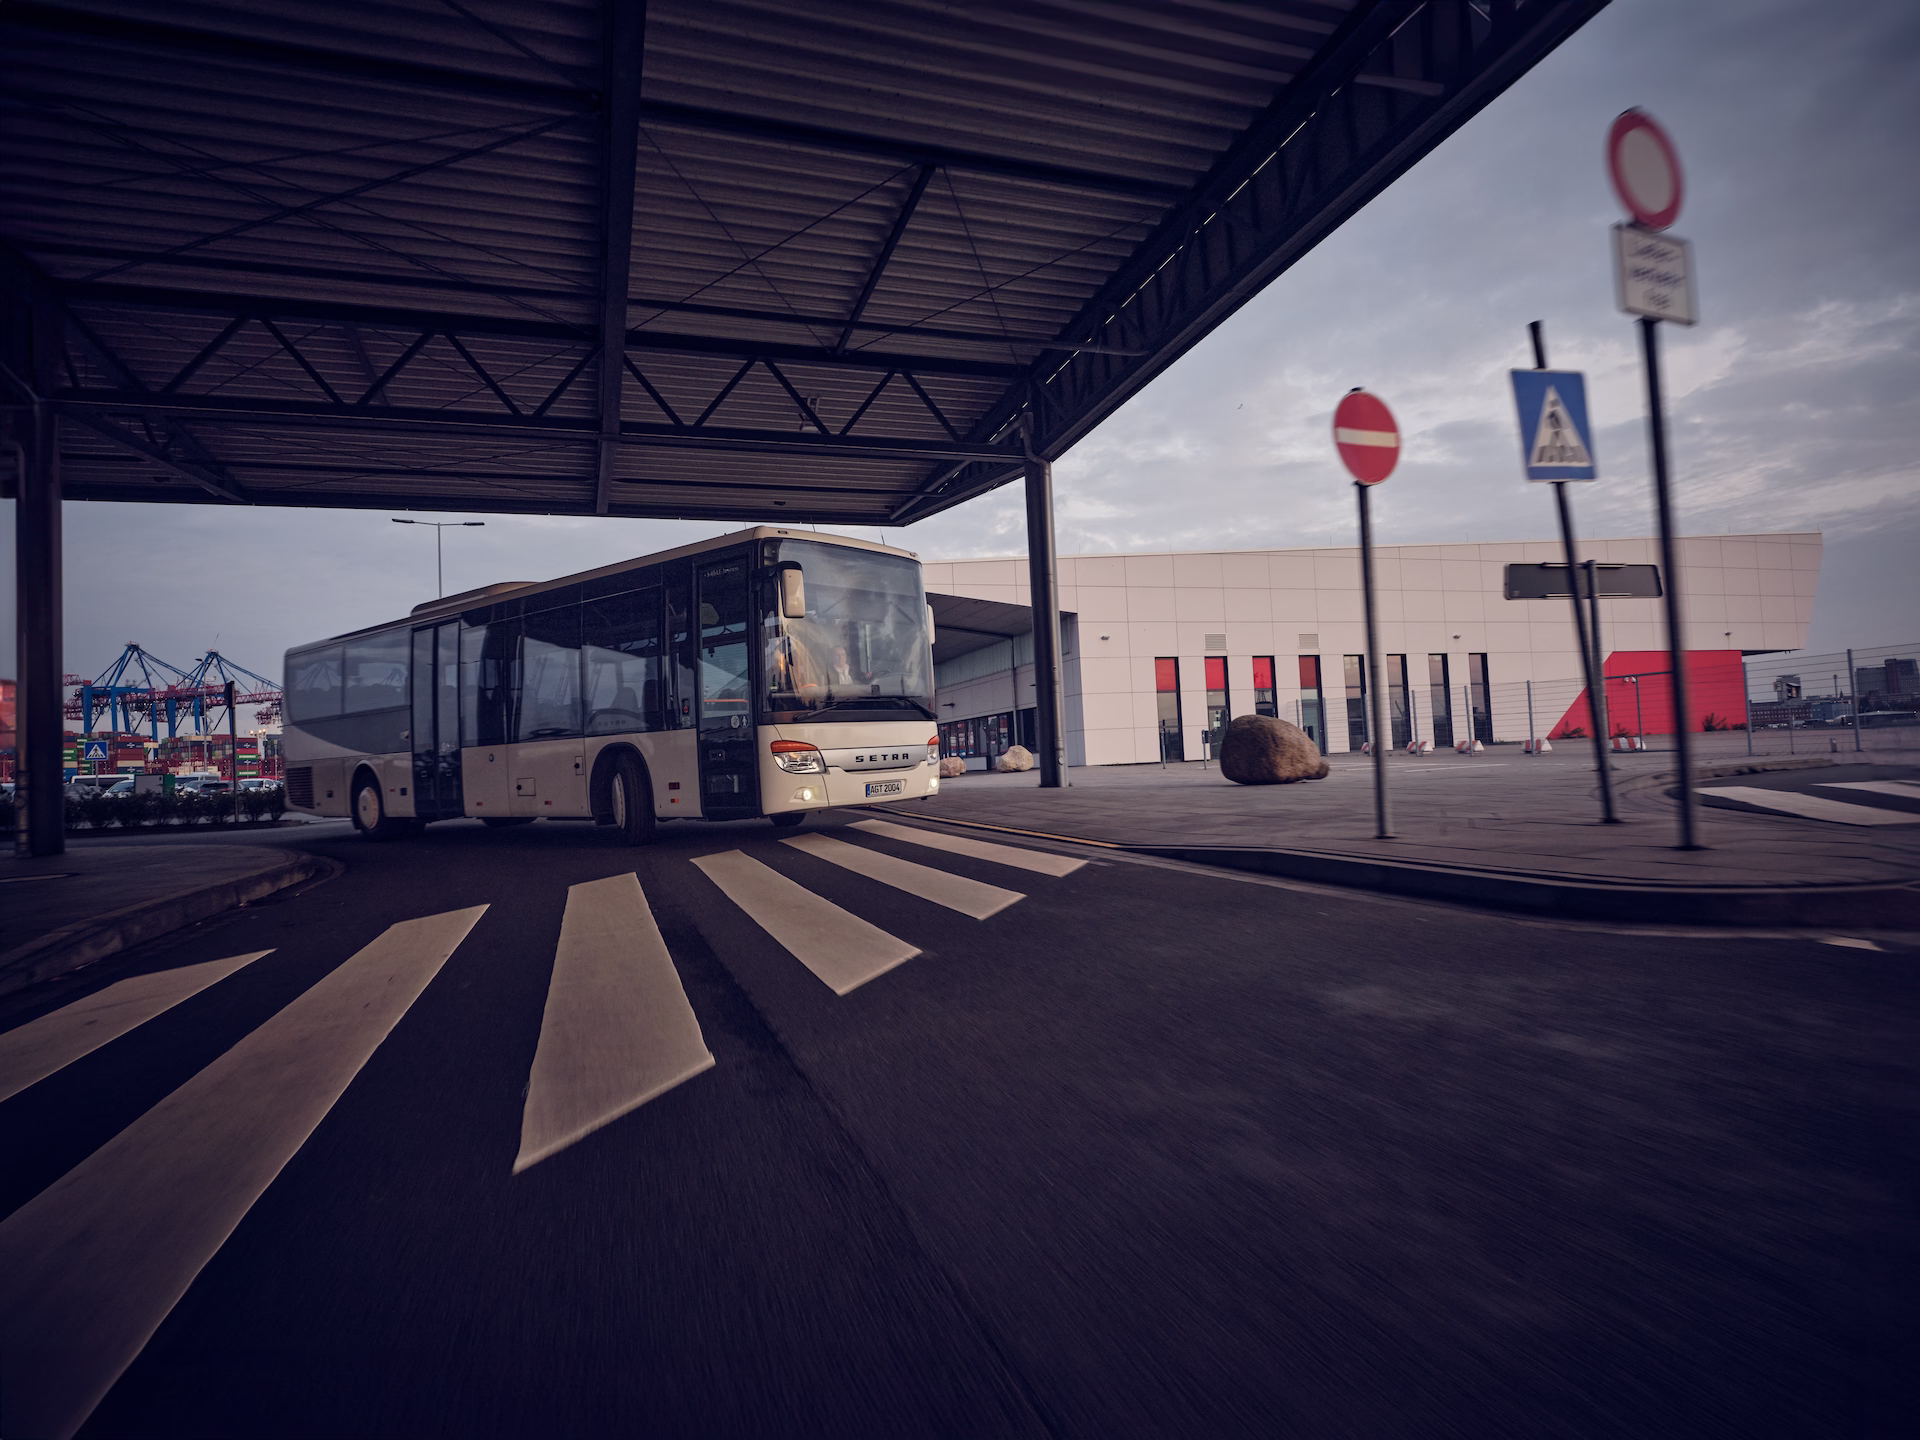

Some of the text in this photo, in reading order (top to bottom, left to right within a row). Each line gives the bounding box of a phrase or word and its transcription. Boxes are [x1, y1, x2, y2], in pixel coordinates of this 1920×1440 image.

[856, 753, 909, 762] SETRA
[870, 785, 883, 794] AGT
[884, 784, 900, 792] 2004
